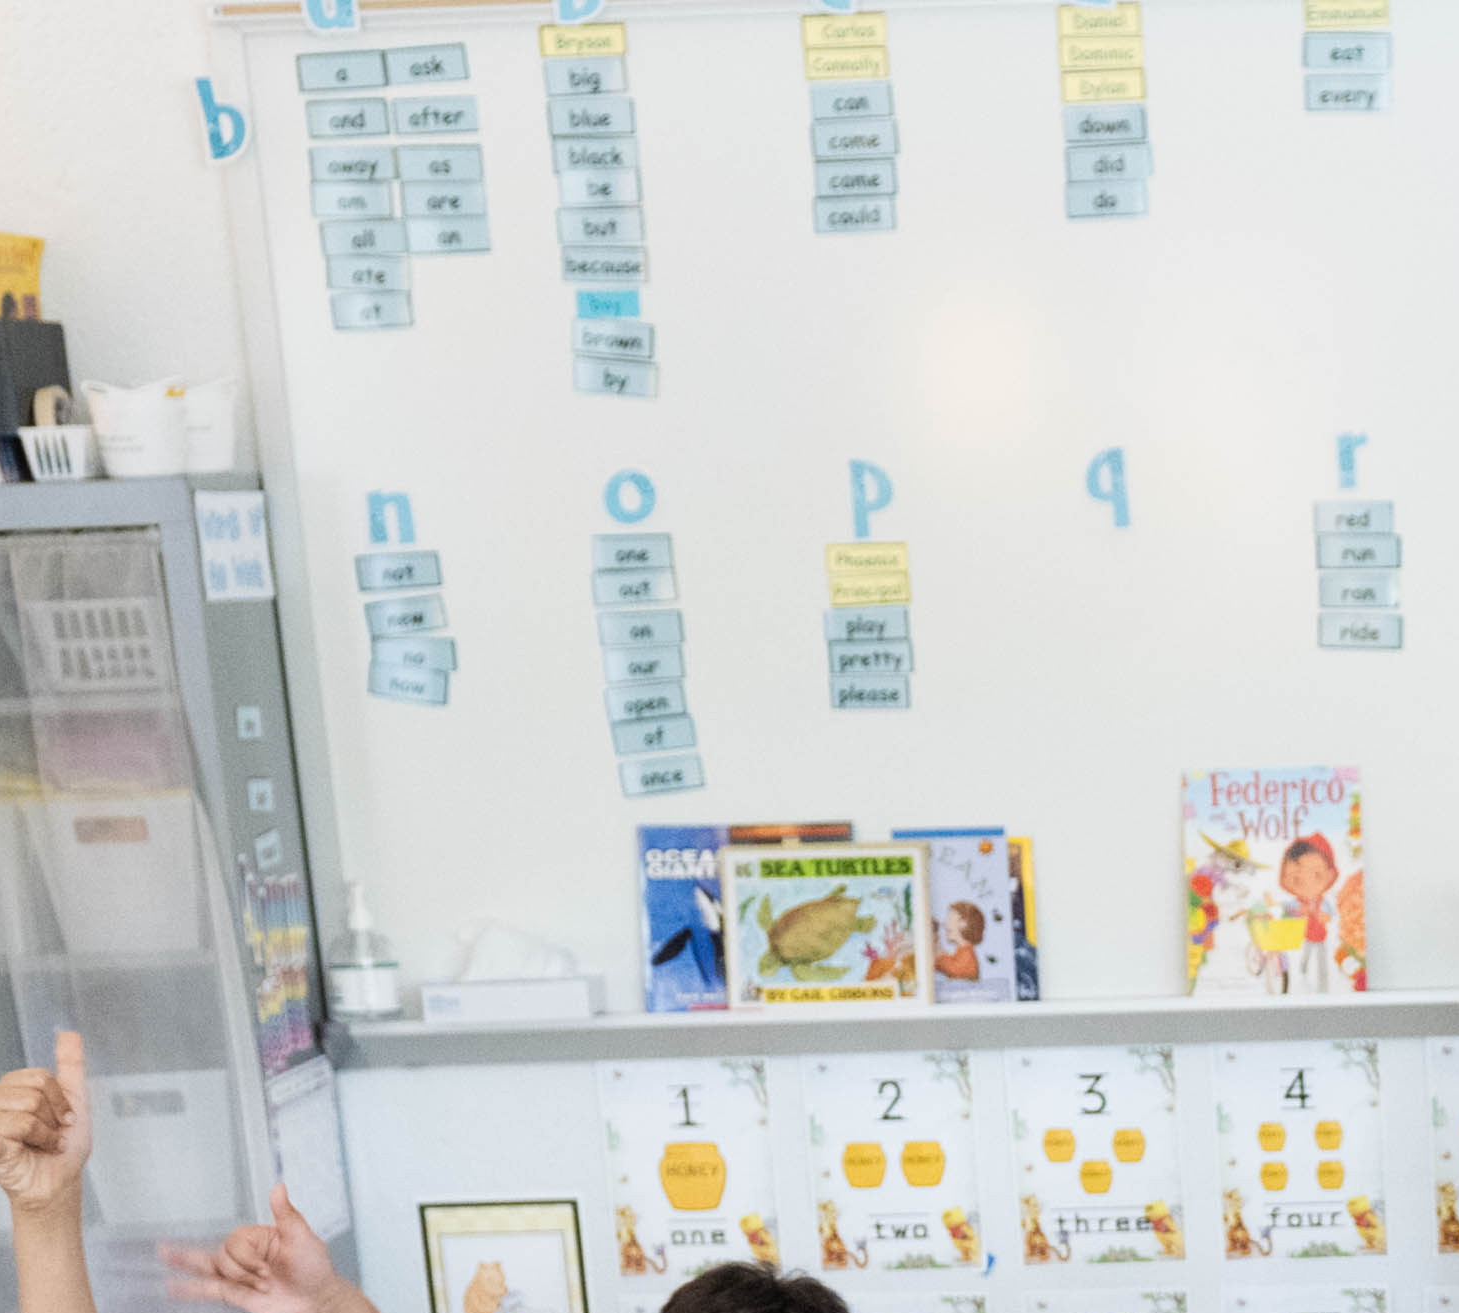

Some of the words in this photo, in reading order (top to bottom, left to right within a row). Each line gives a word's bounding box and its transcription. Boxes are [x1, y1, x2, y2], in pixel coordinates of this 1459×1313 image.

[1328, 42, 1366, 62] eat
[408, 55, 447, 79] ask
[566, 66, 604, 96] big
[832, 94, 870, 113] can
[1318, 86, 1379, 112] every
[194, 77, 245, 160] b
[328, 107, 366, 130] and
[408, 103, 466, 128] after
[567, 106, 614, 128] blue
[1077, 114, 1132, 137] down
[827, 131, 882, 153] come
[326, 157, 380, 182] away
[427, 158, 454, 177] as
[567, 148, 624, 169] black
[1090, 155, 1128, 177] did
[584, 180, 614, 199] be
[1091, 190, 1120, 212] do
[425, 193, 462, 212] are
[350, 227, 378, 250] all
[437, 229, 462, 246] an
[581, 215, 618, 239] but
[564, 253, 642, 274] because
[351, 265, 388, 286] ate
[581, 327, 645, 353] brown
[602, 365, 632, 395] by
[1336, 432, 1370, 490] r
[604, 469, 657, 524] o
[849, 459, 894, 538] p
[1086, 447, 1129, 527] q
[367, 490, 414, 543] n
[1334, 508, 1372, 531] red
[614, 548, 653, 564] one
[1341, 545, 1377, 564] run
[383, 562, 415, 584] not
[618, 578, 652, 598] out
[1342, 583, 1377, 601] ran
[629, 624, 656, 642] on
[844, 613, 887, 642] play
[1340, 620, 1381, 643] ride
[627, 658, 663, 677] our
[838, 650, 904, 677] pretty
[623, 695, 671, 720] open
[837, 682, 902, 710] please
[643, 724, 665, 747] of
[640, 767, 686, 789] once
[1209, 769, 1346, 809] Federico
[1238, 805, 1308, 844] Wolf
[761, 856, 806, 877] SEA
[813, 855, 913, 877] TURTLES
[1077, 1073, 1108, 1115] 3
[1284, 1068, 1311, 1109] 4
[675, 1086, 699, 1127] 1
[877, 1079, 905, 1122] 2
[665, 1162, 720, 1179] HONEY
[874, 1221, 930, 1240] two
[1057, 1211, 1152, 1233] three
[1269, 1207, 1343, 1231] four
[670, 1229, 727, 1246] one
